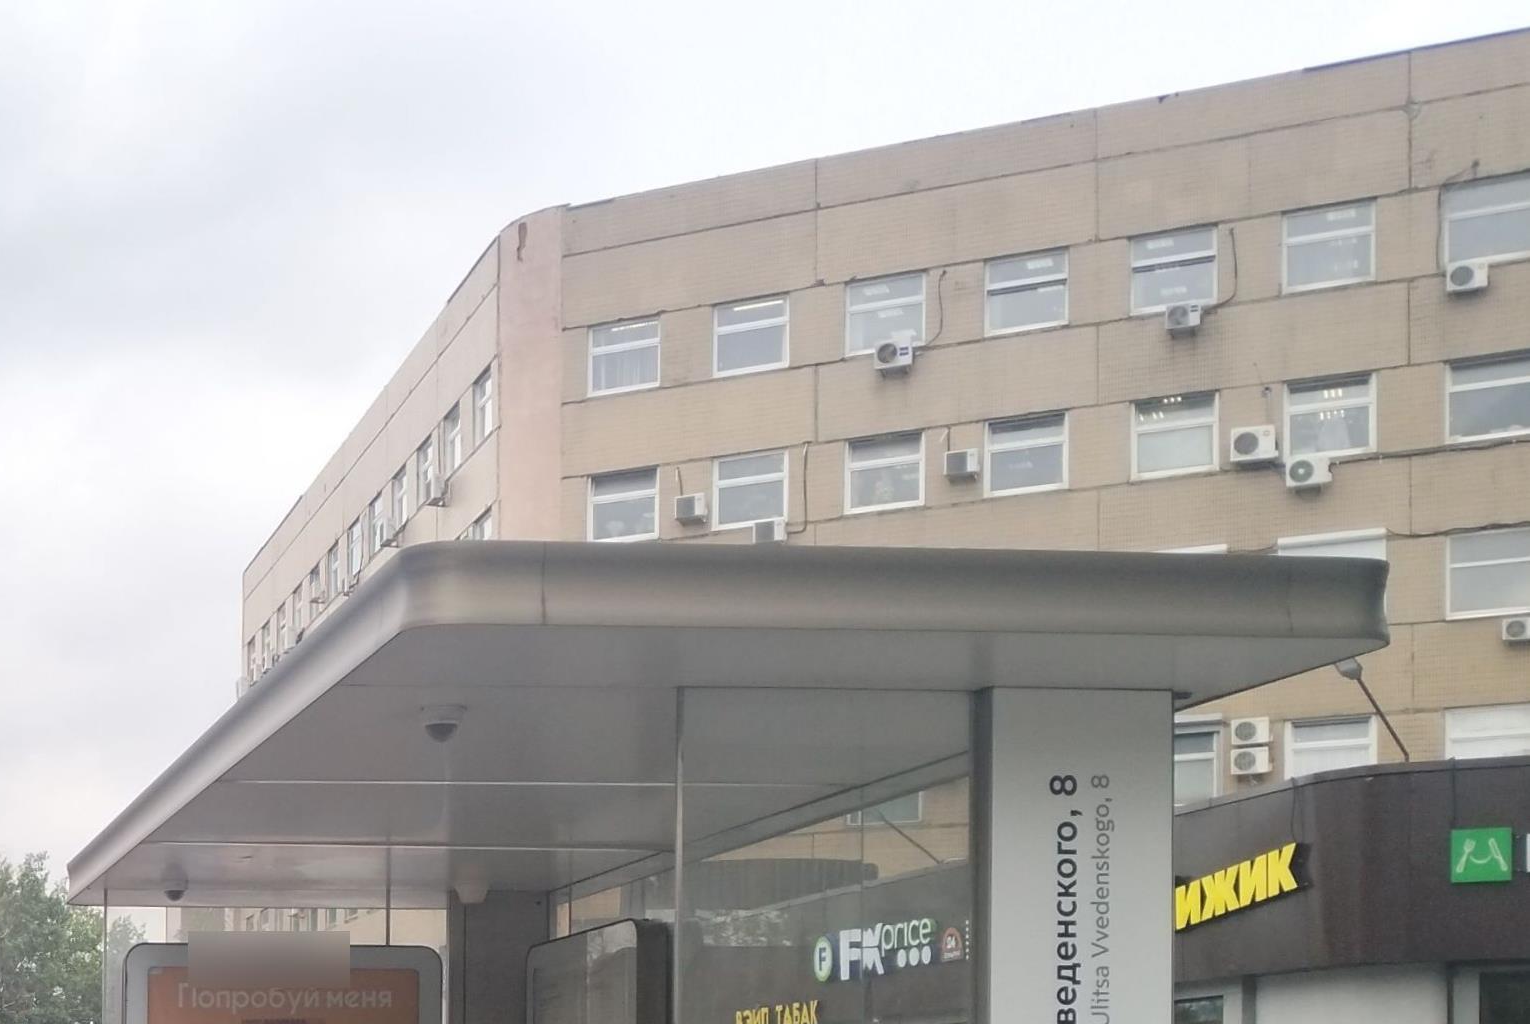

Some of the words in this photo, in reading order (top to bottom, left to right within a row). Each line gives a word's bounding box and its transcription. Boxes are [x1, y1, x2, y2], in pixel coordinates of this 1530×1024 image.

[1048, 774, 1078, 796] 8
[1090, 773, 1111, 789] 8
[1089, 796, 1116, 958] Vvedenskogo,
[177, 982, 320, 1015] Попробуй
[325, 988, 393, 1009] меня
